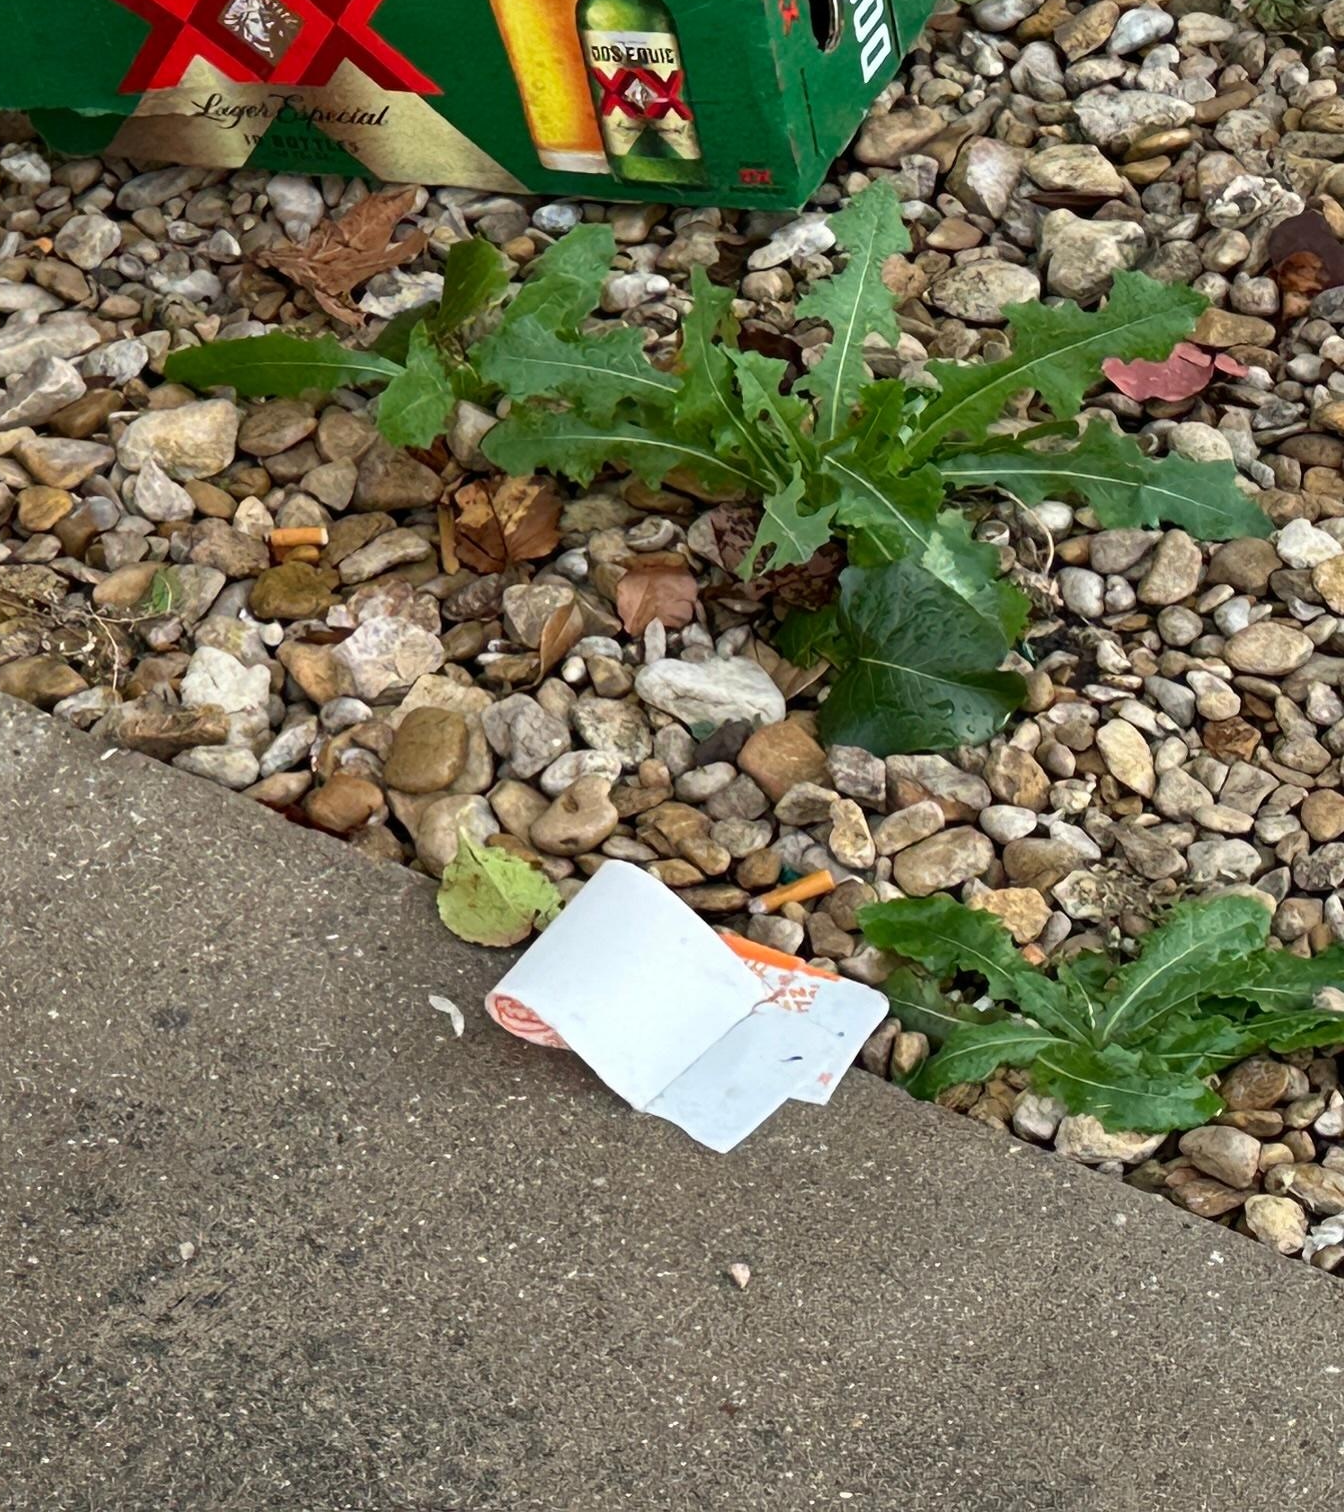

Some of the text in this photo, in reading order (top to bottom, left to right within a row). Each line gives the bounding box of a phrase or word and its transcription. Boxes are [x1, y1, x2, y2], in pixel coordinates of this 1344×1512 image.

[591, 45, 623, 63] DOS
[191, 91, 391, 131] Lager Especial
